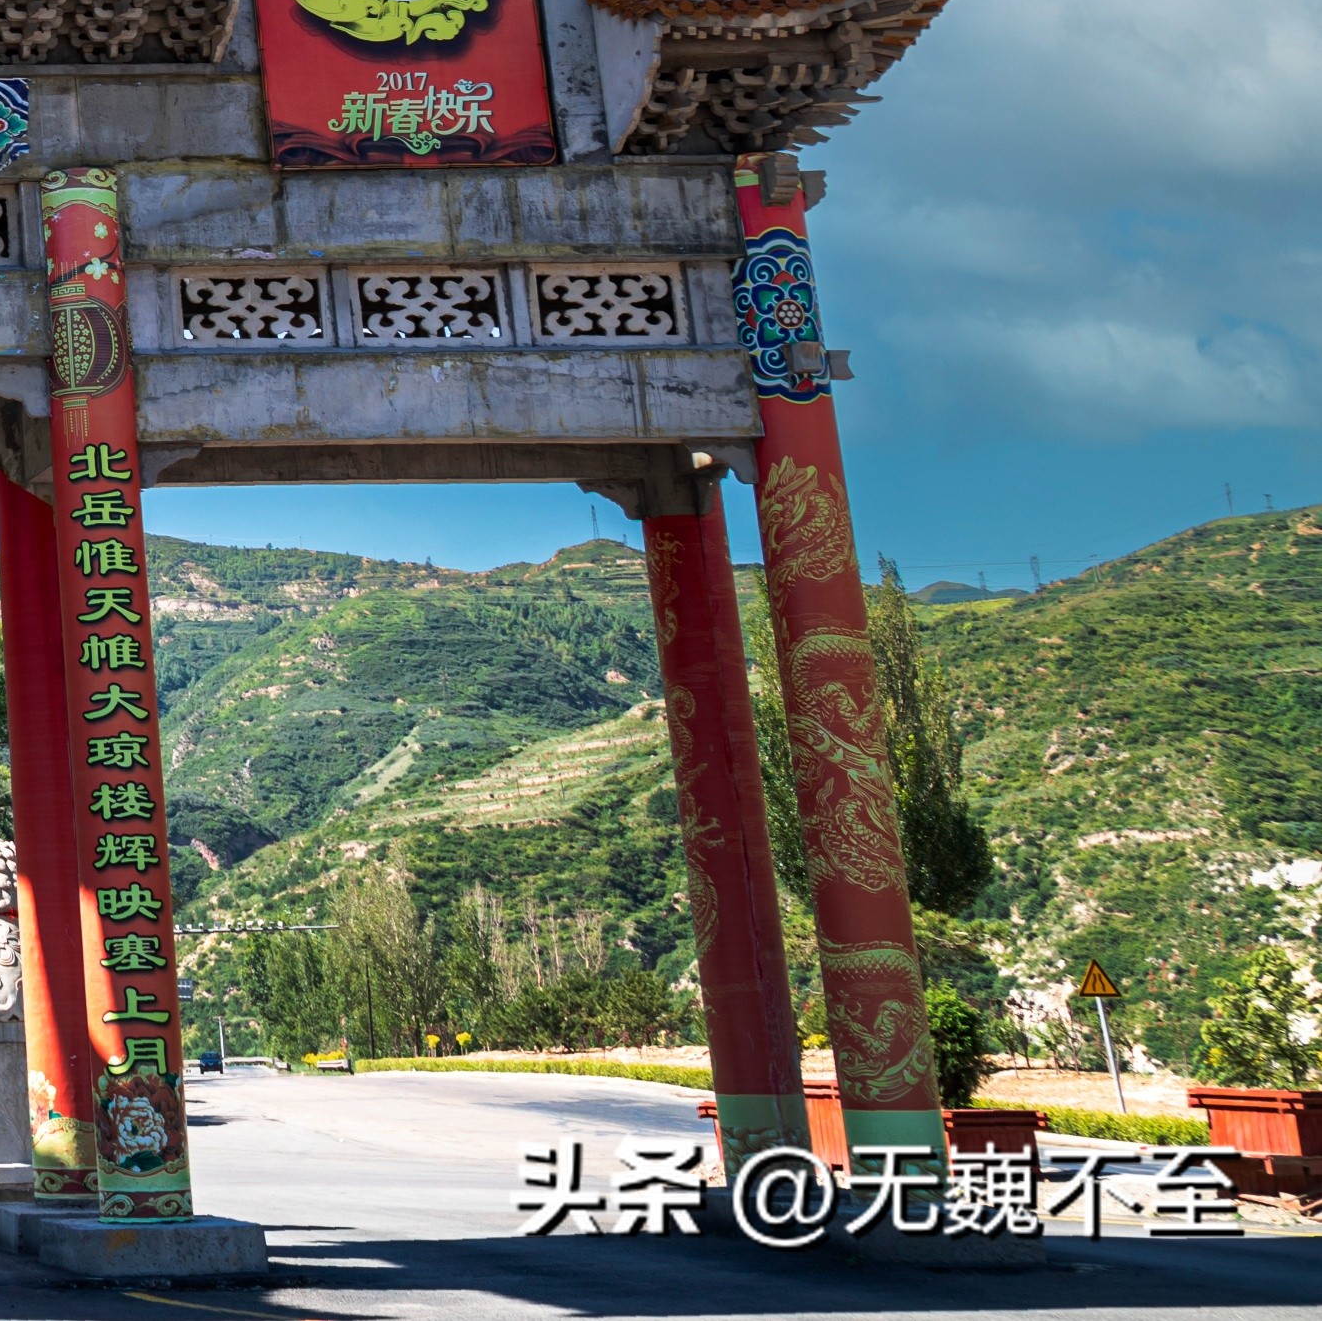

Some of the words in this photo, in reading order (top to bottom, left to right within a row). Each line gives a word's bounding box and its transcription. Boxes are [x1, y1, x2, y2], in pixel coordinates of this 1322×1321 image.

[376, 71, 429, 92] 2017
[327, 80, 495, 142] 新春快乐
